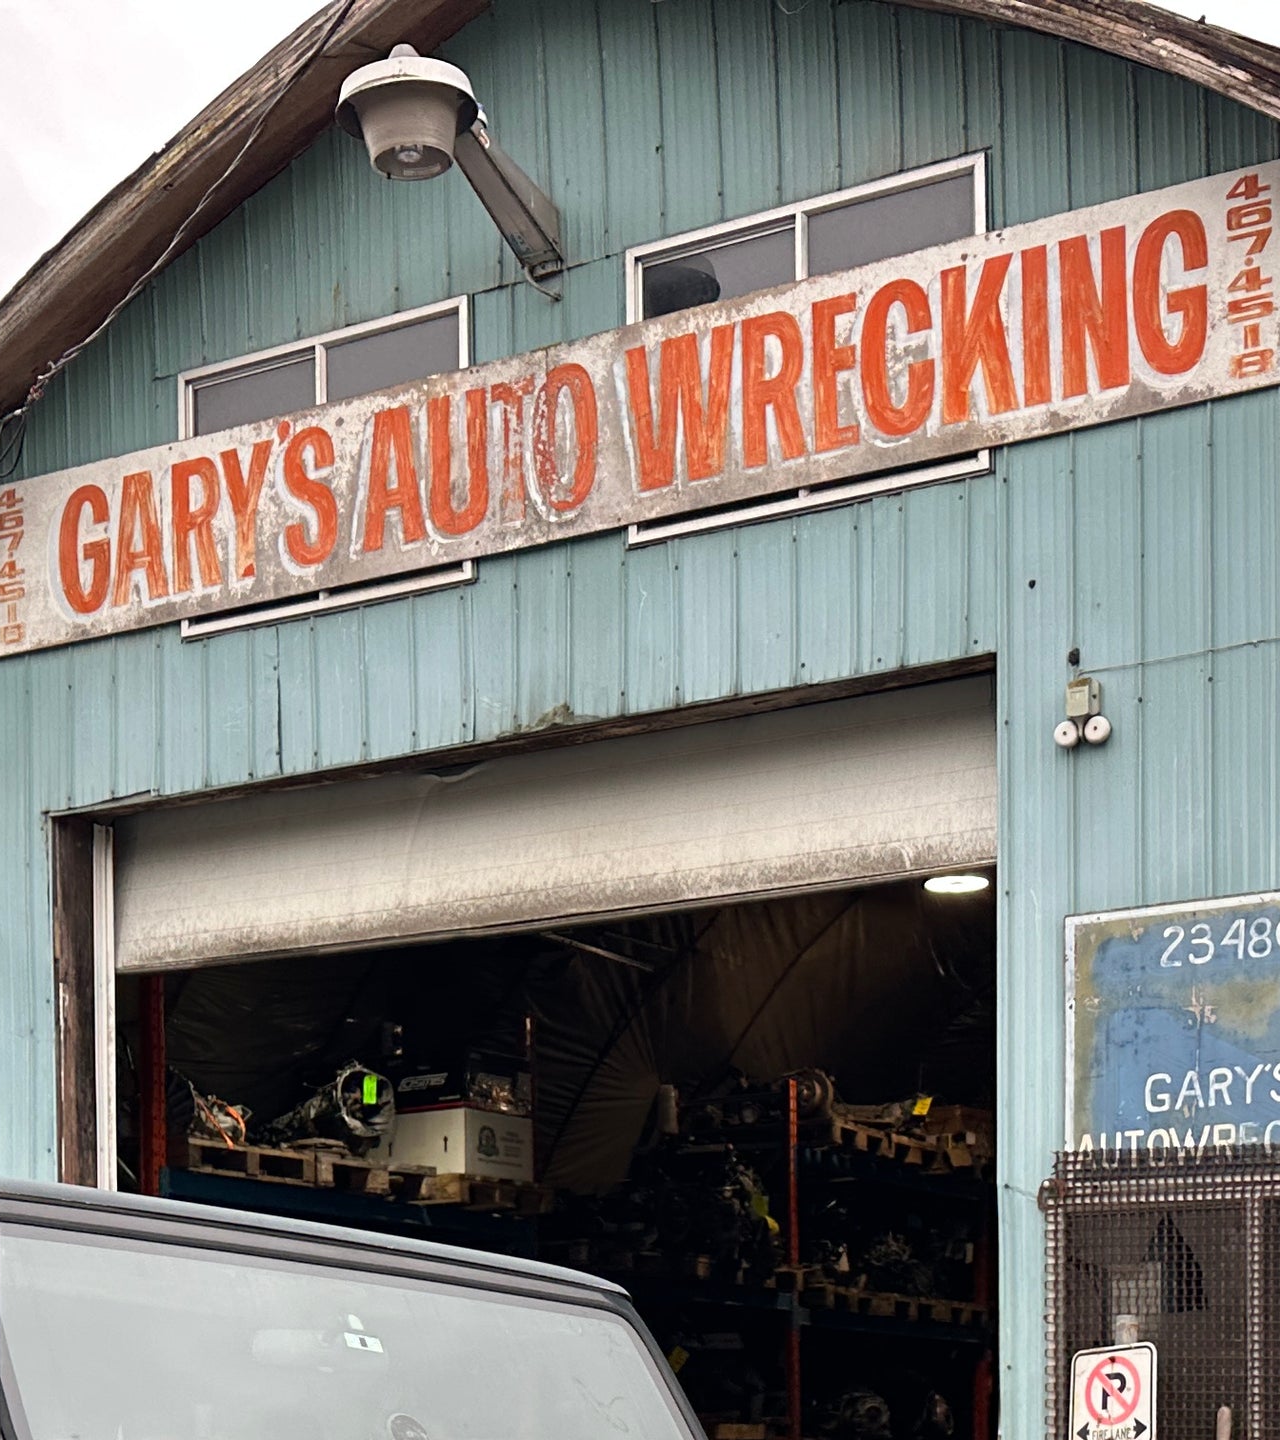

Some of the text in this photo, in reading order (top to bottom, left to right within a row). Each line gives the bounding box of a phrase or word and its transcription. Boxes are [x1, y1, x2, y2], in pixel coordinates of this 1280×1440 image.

[58, 208, 1208, 614] GARY'S AUTO WRECKING
[1091, 1426, 1132, 1440] FIRE LANE
